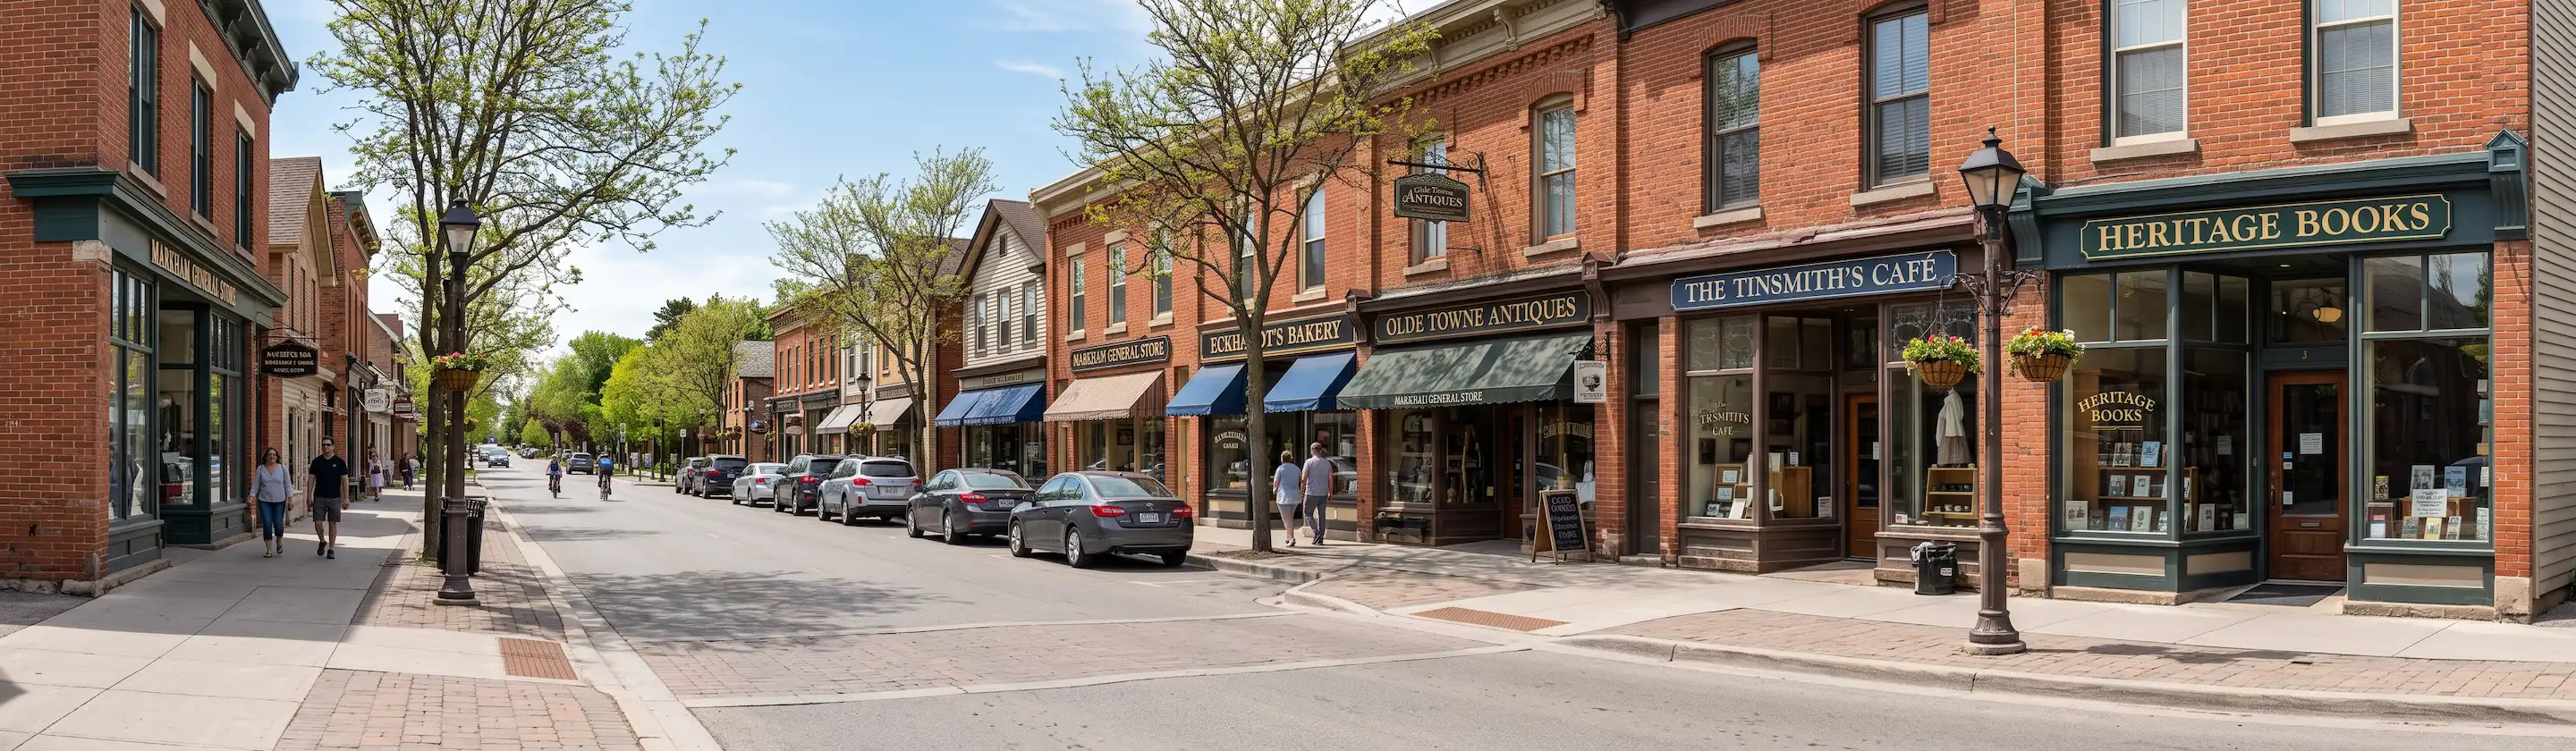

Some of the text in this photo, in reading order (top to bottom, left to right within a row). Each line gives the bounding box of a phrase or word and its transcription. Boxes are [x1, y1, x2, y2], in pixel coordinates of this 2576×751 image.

[1402, 189, 1463, 207] ANTIQUES
[2097, 202, 2430, 252] HERITAGE BOOKS
[151, 239, 191, 283] MARKHAM
[1684, 253, 1936, 303] THE TINSMITH'S CAFÉ
[1386, 297, 1576, 336] OLDE TOWNE ANTIQUES
[1108, 345, 1140, 362] GENERAL
[1140, 341, 1165, 358] STORE
[1210, 320, 1342, 354] ECKHAT'S BAKERY
[1428, 393, 1460, 404] GENERAL
[1460, 392, 1483, 401] STORE
[2077, 391, 2156, 422] HERITAGE BOOKS
[1712, 426, 1733, 435] CAFE
